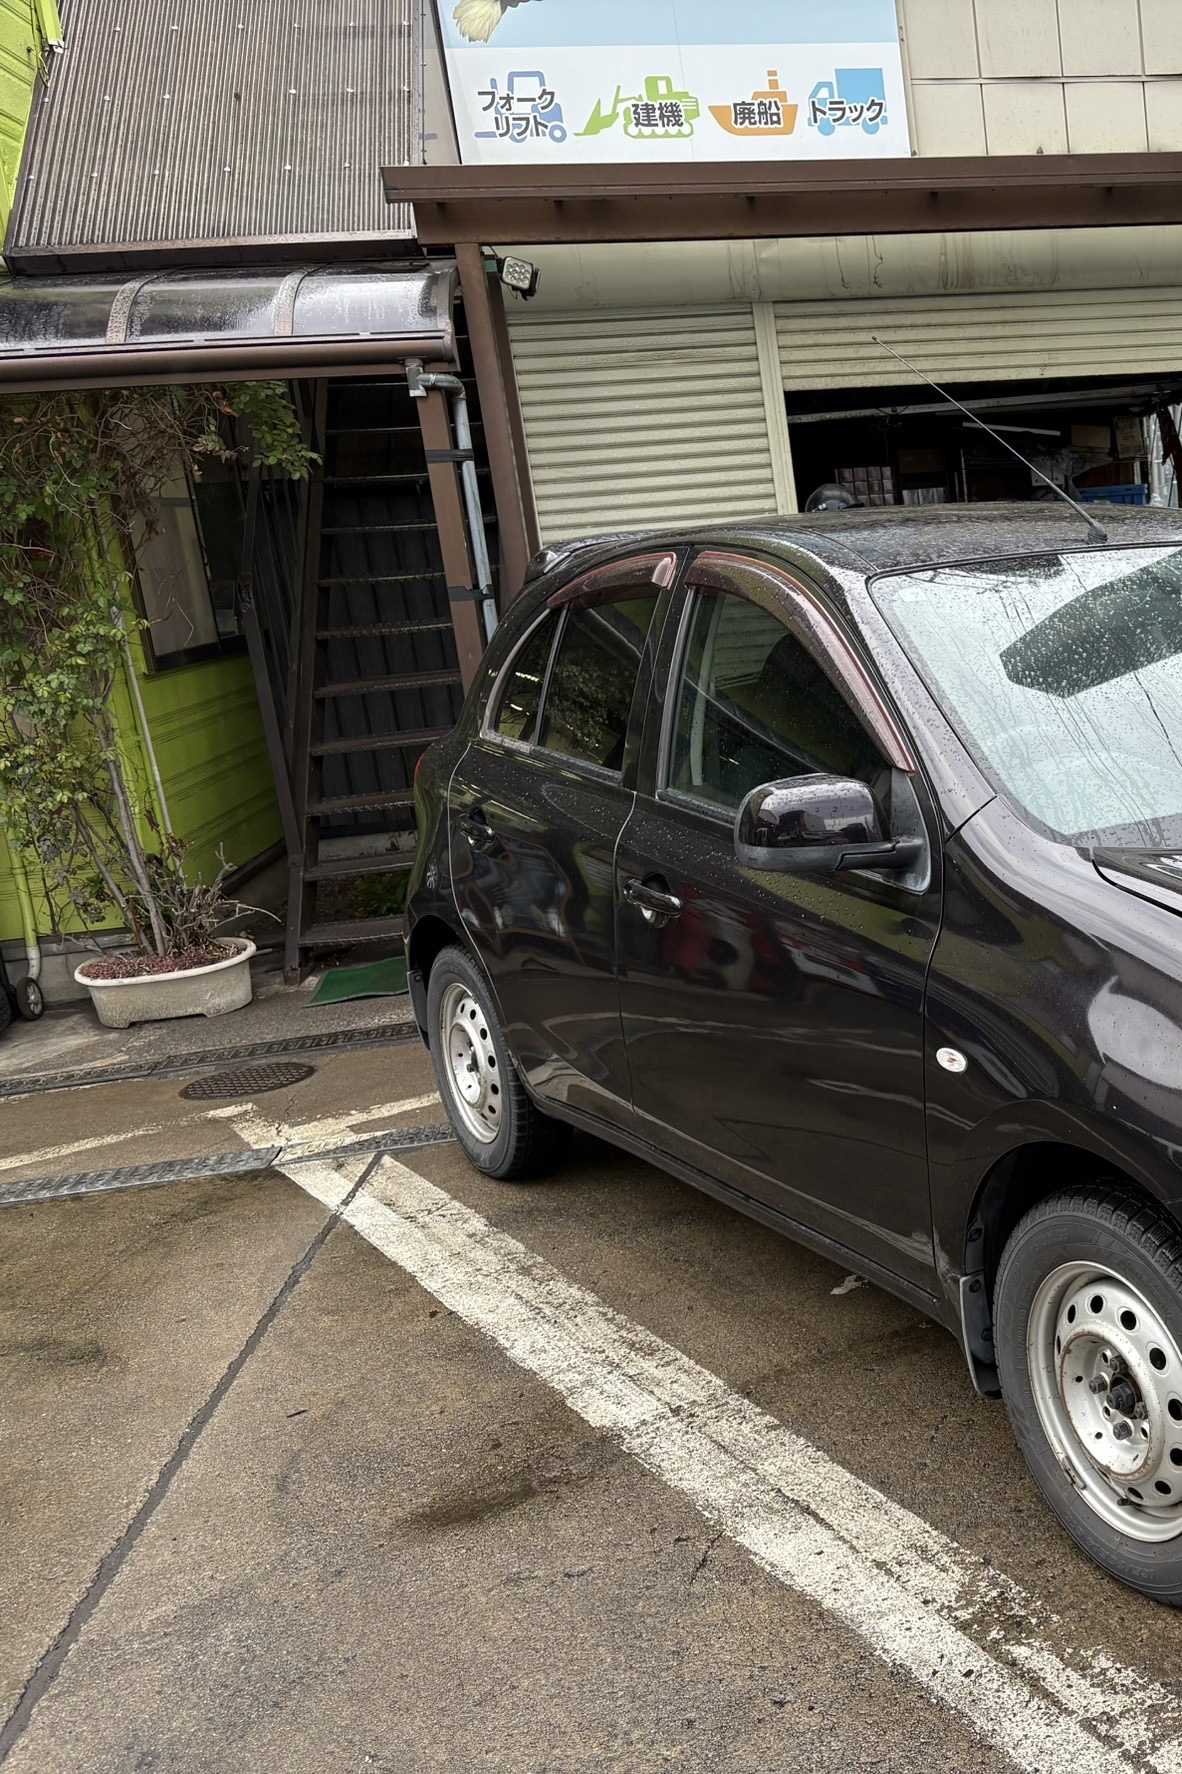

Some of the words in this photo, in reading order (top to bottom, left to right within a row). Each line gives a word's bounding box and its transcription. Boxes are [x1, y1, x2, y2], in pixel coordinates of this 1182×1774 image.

[477, 88, 555, 111] フォーク
[811, 99, 884, 124] トラック
[631, 101, 684, 128] 建機
[732, 100, 782, 127] 廃船
[494, 116, 549, 139] リフト
